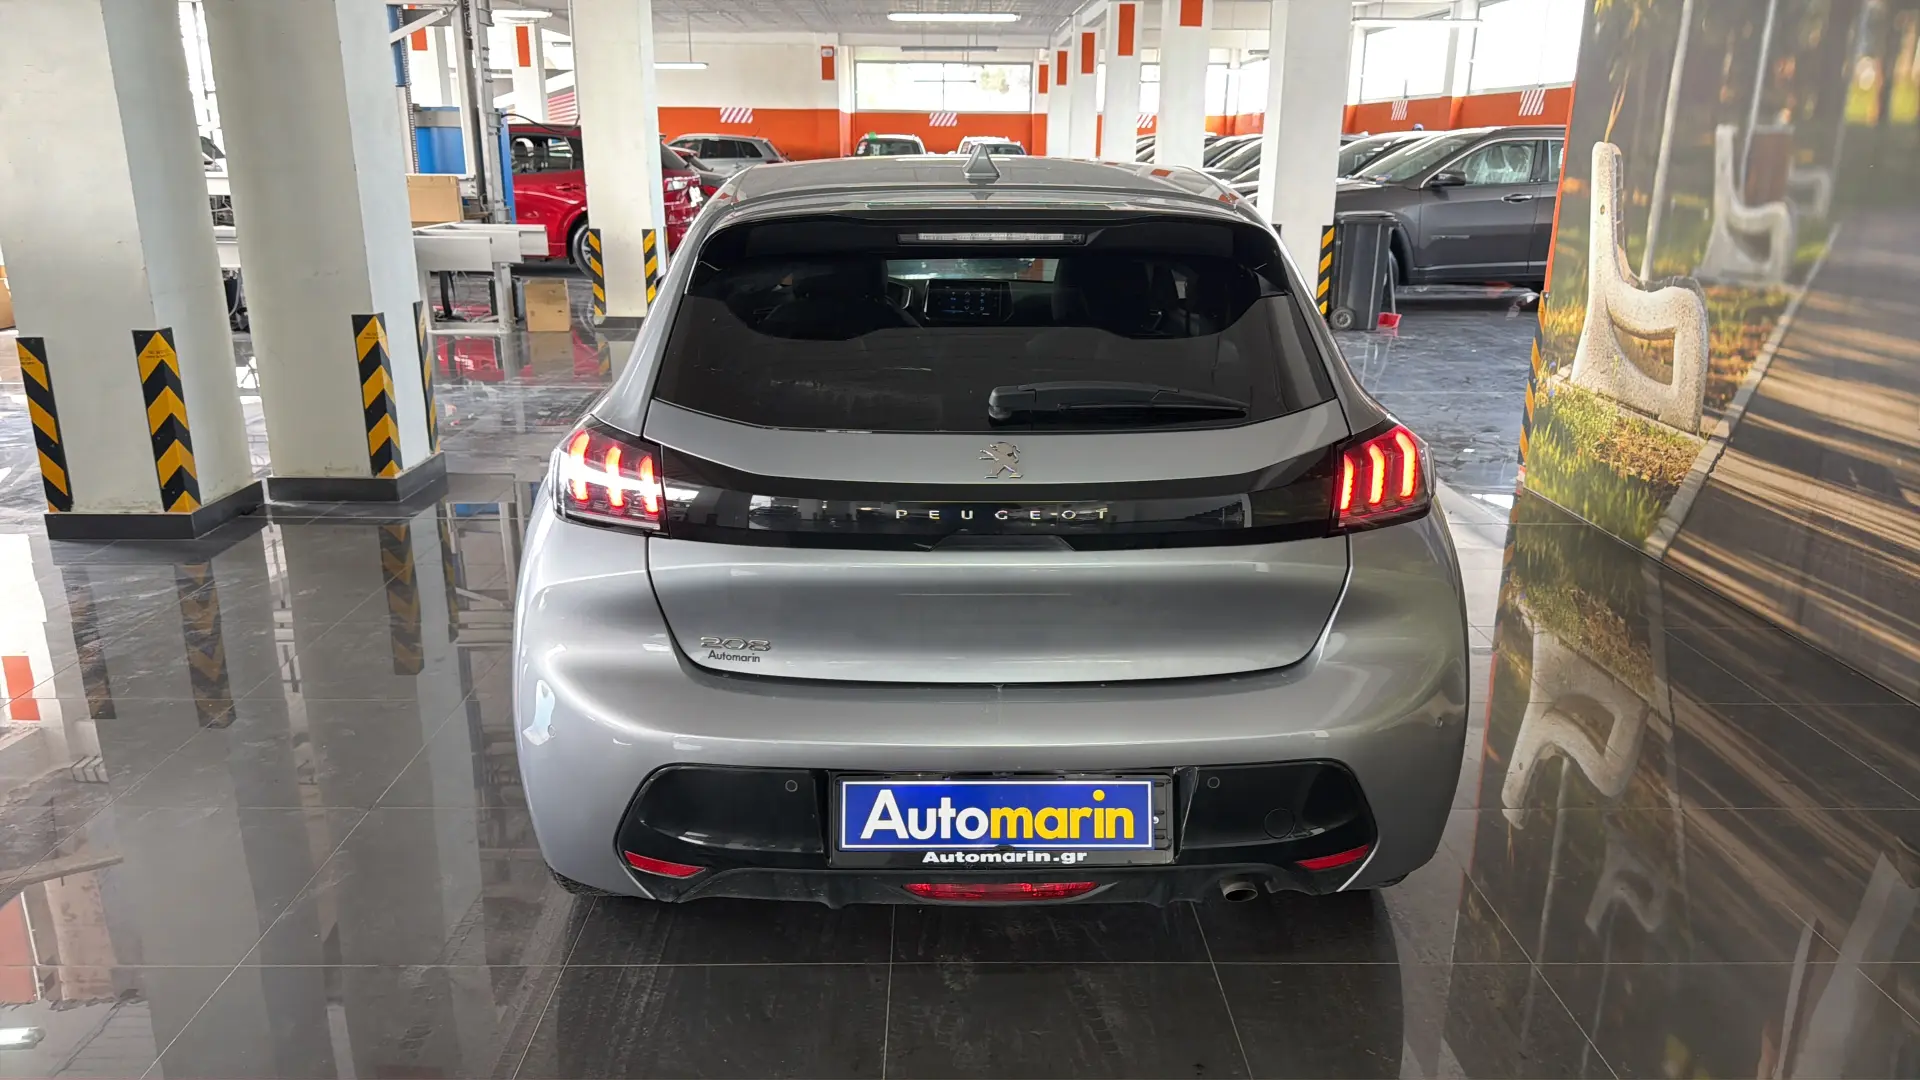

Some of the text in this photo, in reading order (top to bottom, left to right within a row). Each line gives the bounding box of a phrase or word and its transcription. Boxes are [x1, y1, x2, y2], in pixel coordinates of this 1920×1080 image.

[895, 507, 1108, 520] PEUGEOT
[700, 636, 771, 652] 208
[707, 649, 760, 662] Automarin
[859, 789, 1135, 840] Automarin
[922, 850, 1088, 865] Automarin.gr
